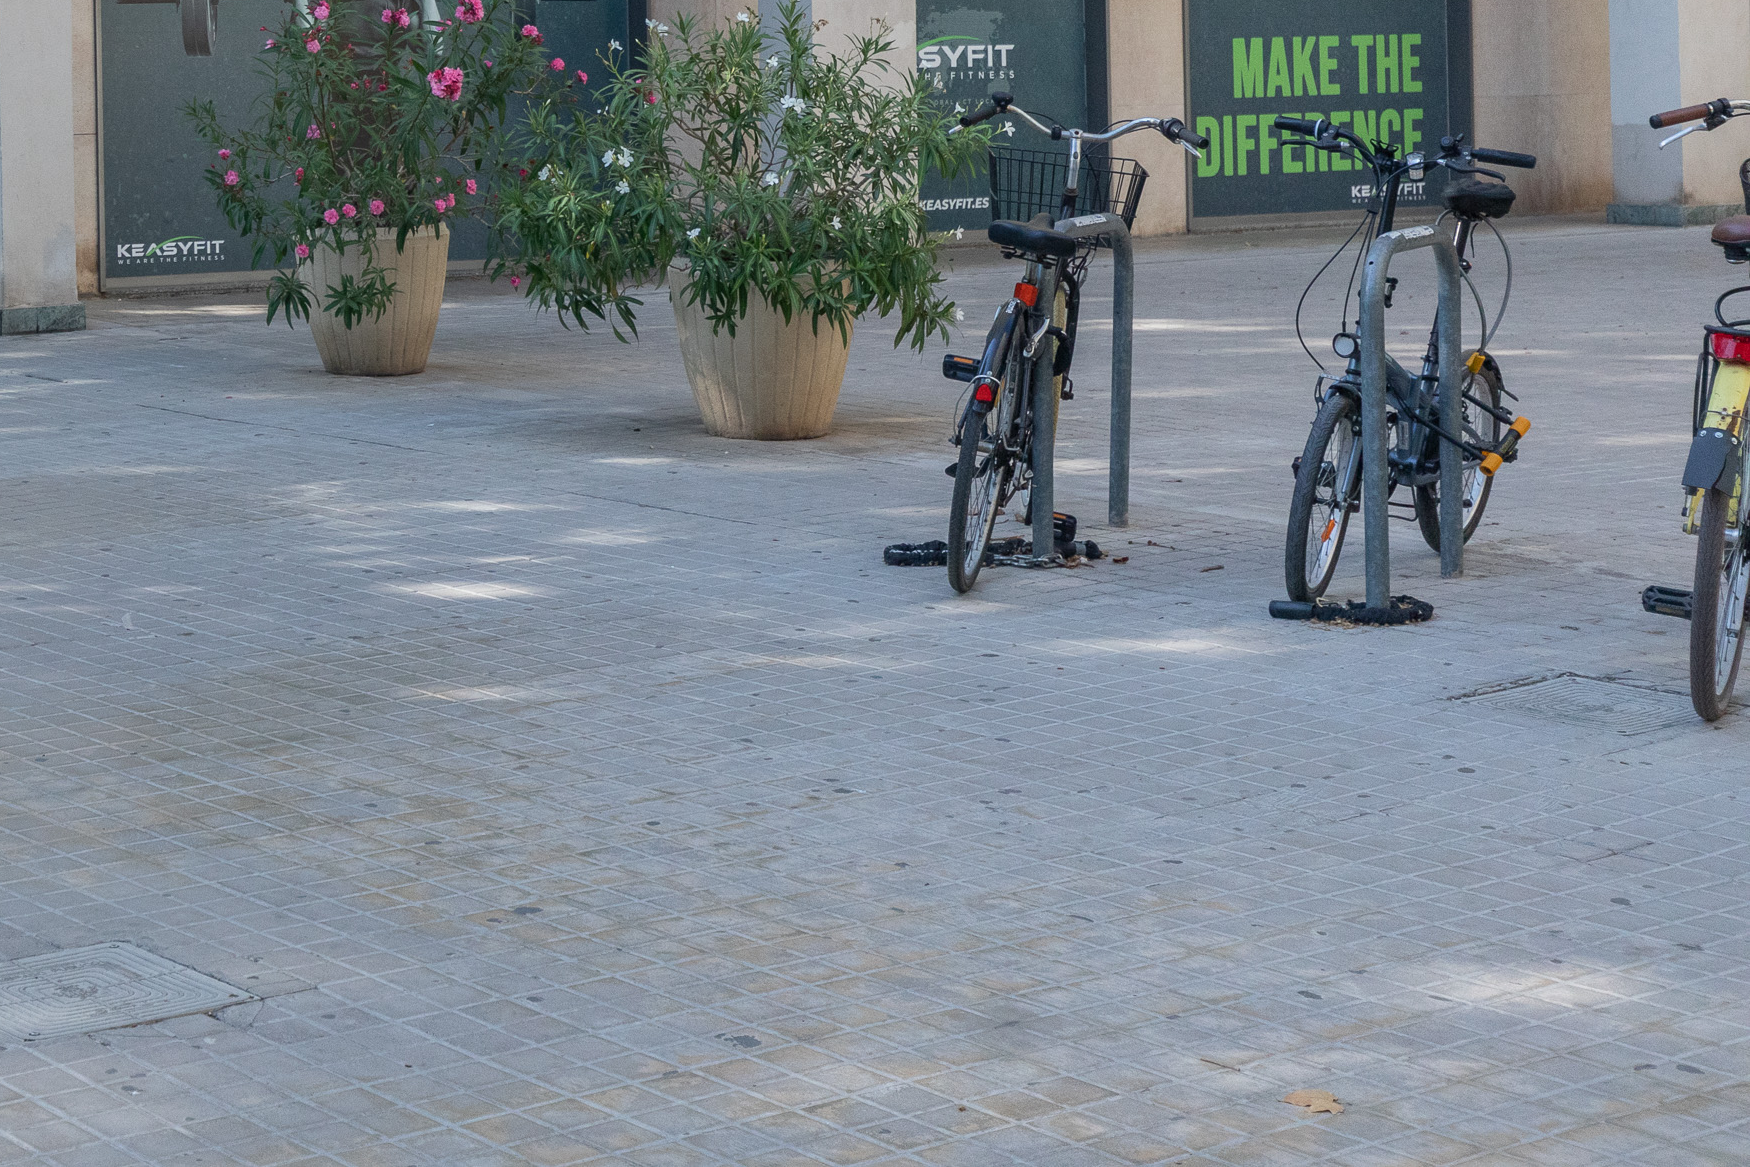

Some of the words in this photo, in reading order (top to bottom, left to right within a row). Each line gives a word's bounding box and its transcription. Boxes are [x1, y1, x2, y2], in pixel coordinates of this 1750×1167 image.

[951, 70, 1015, 80] FITNESS
[1232, 35, 1341, 99] MAKE
[1351, 33, 1423, 95] THE
[117, 240, 225, 258] KEASYFIT
